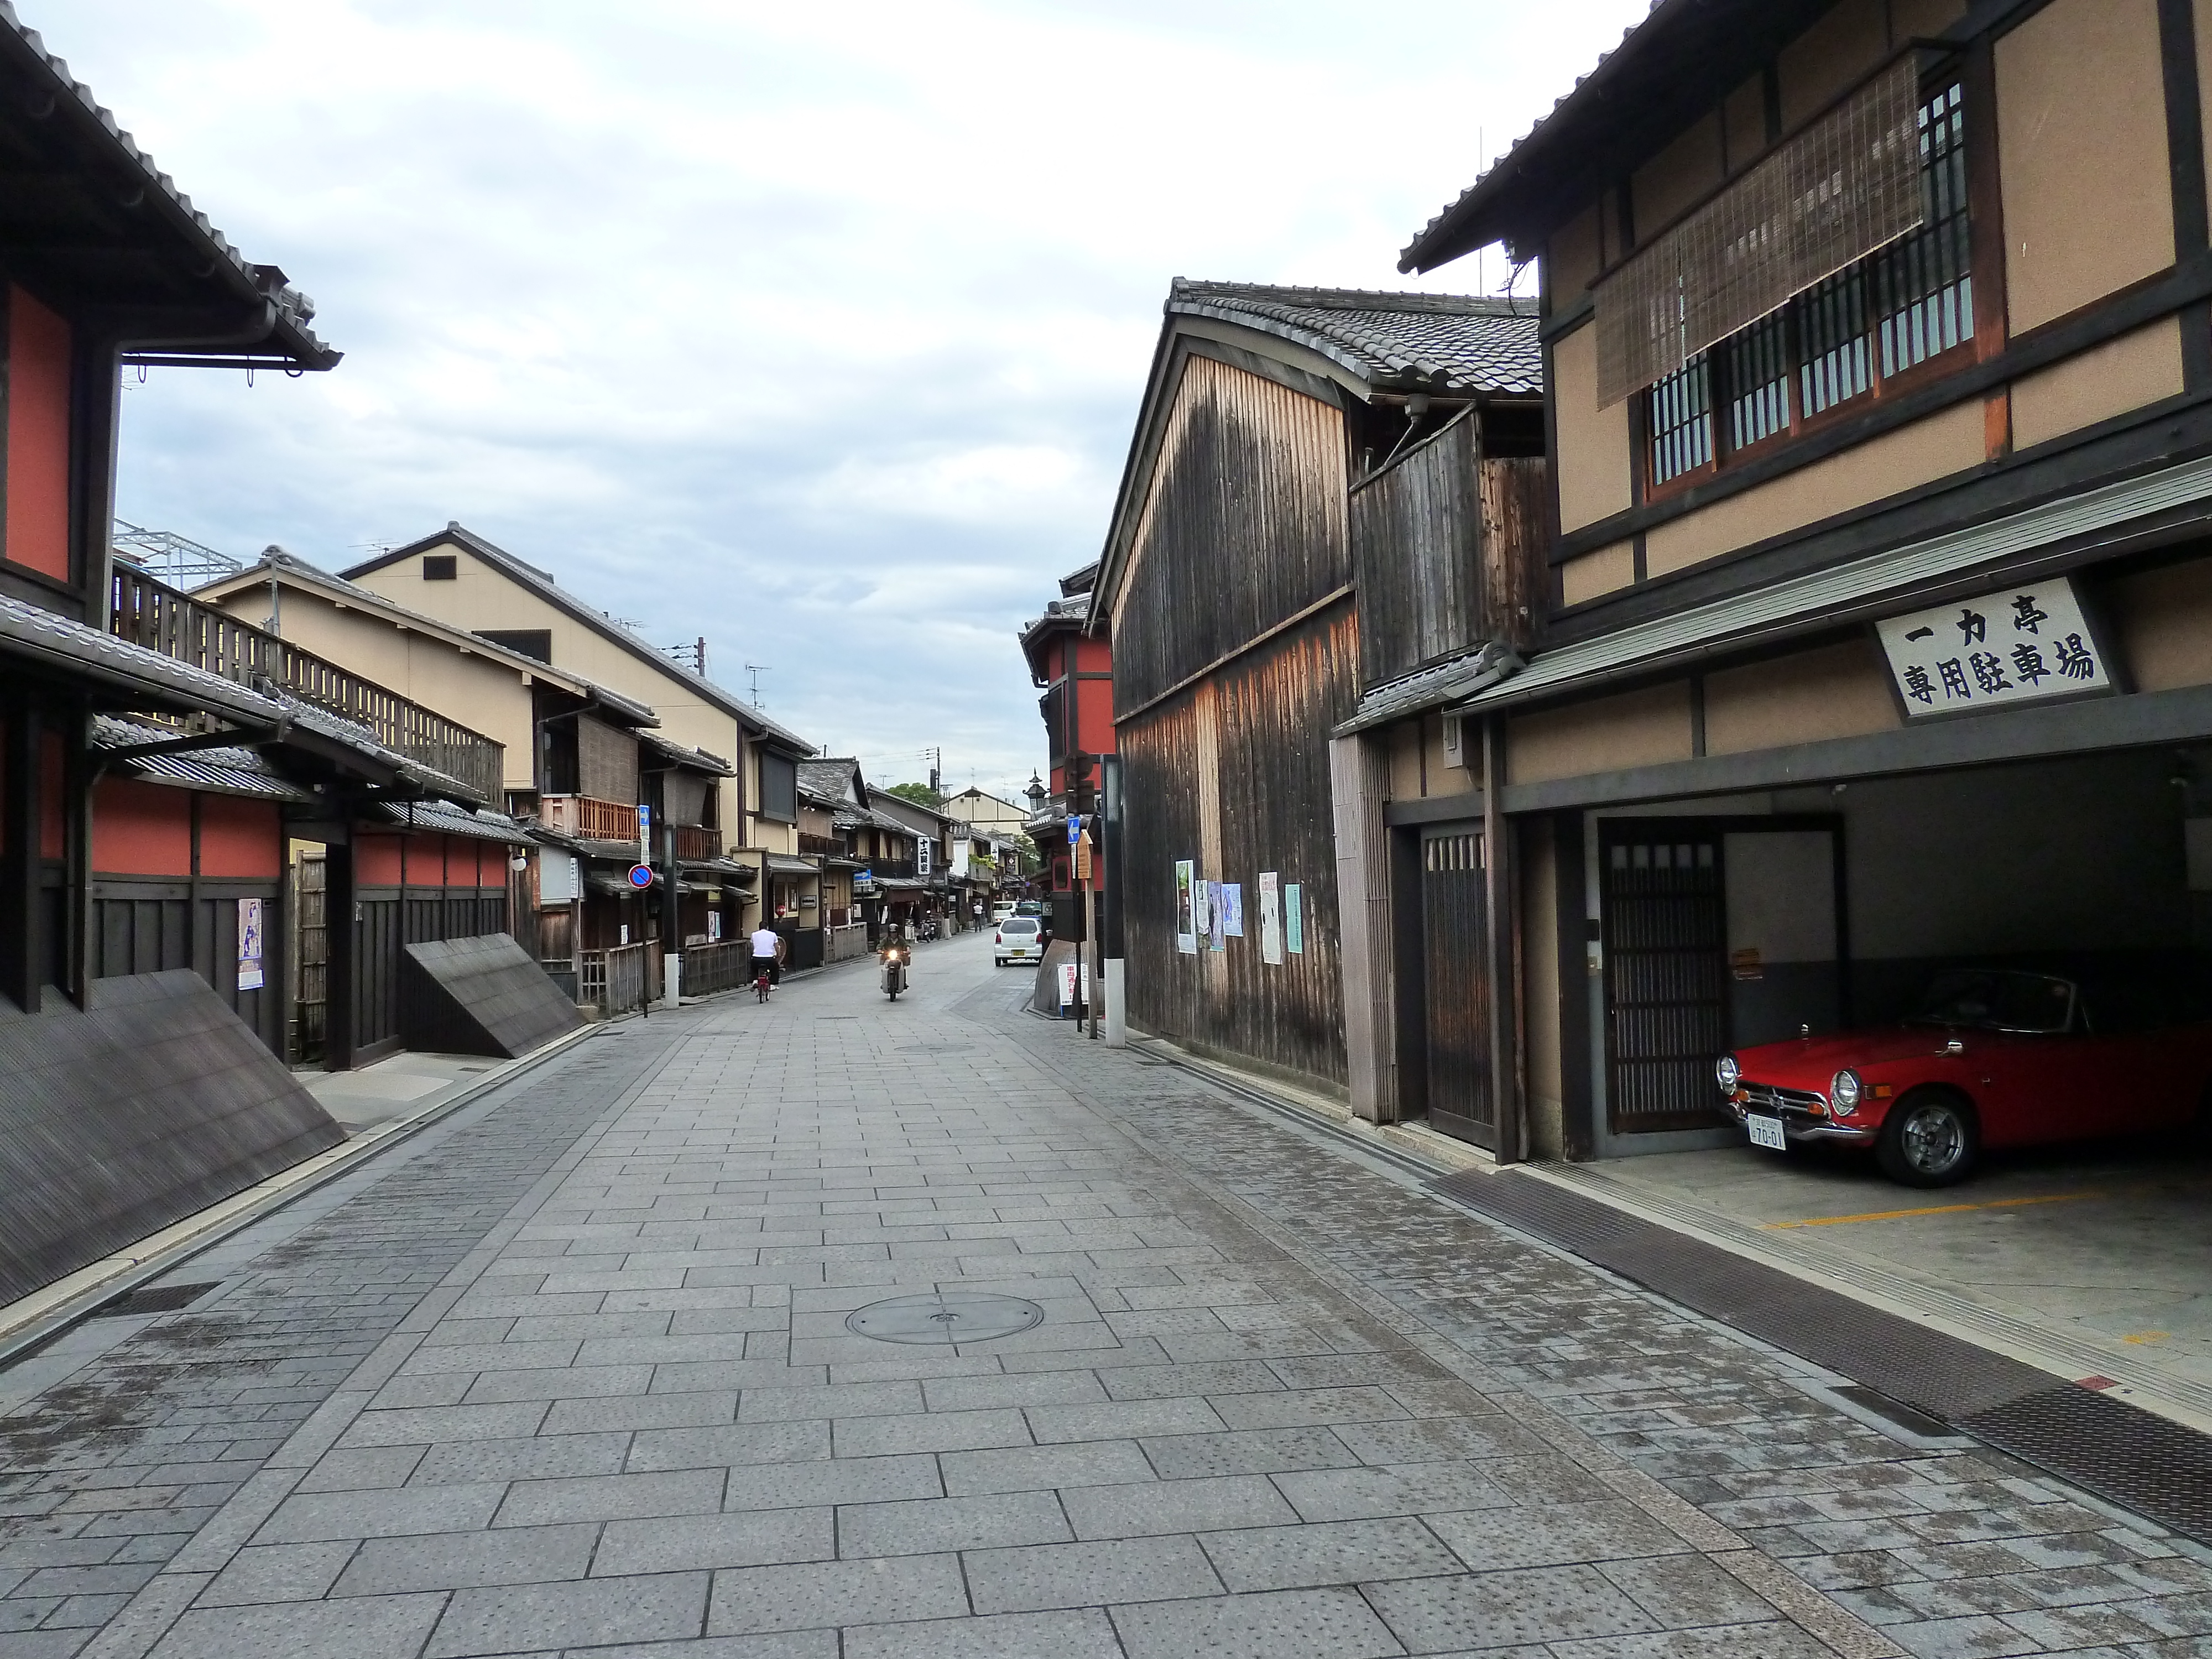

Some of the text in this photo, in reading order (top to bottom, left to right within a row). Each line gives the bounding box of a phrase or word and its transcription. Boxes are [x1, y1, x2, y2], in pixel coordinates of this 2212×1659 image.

[1905, 594, 2048, 646] 一力亭
[1903, 632, 2094, 705] 専用駐車場
[1756, 1127, 1782, 1147] 70-01
